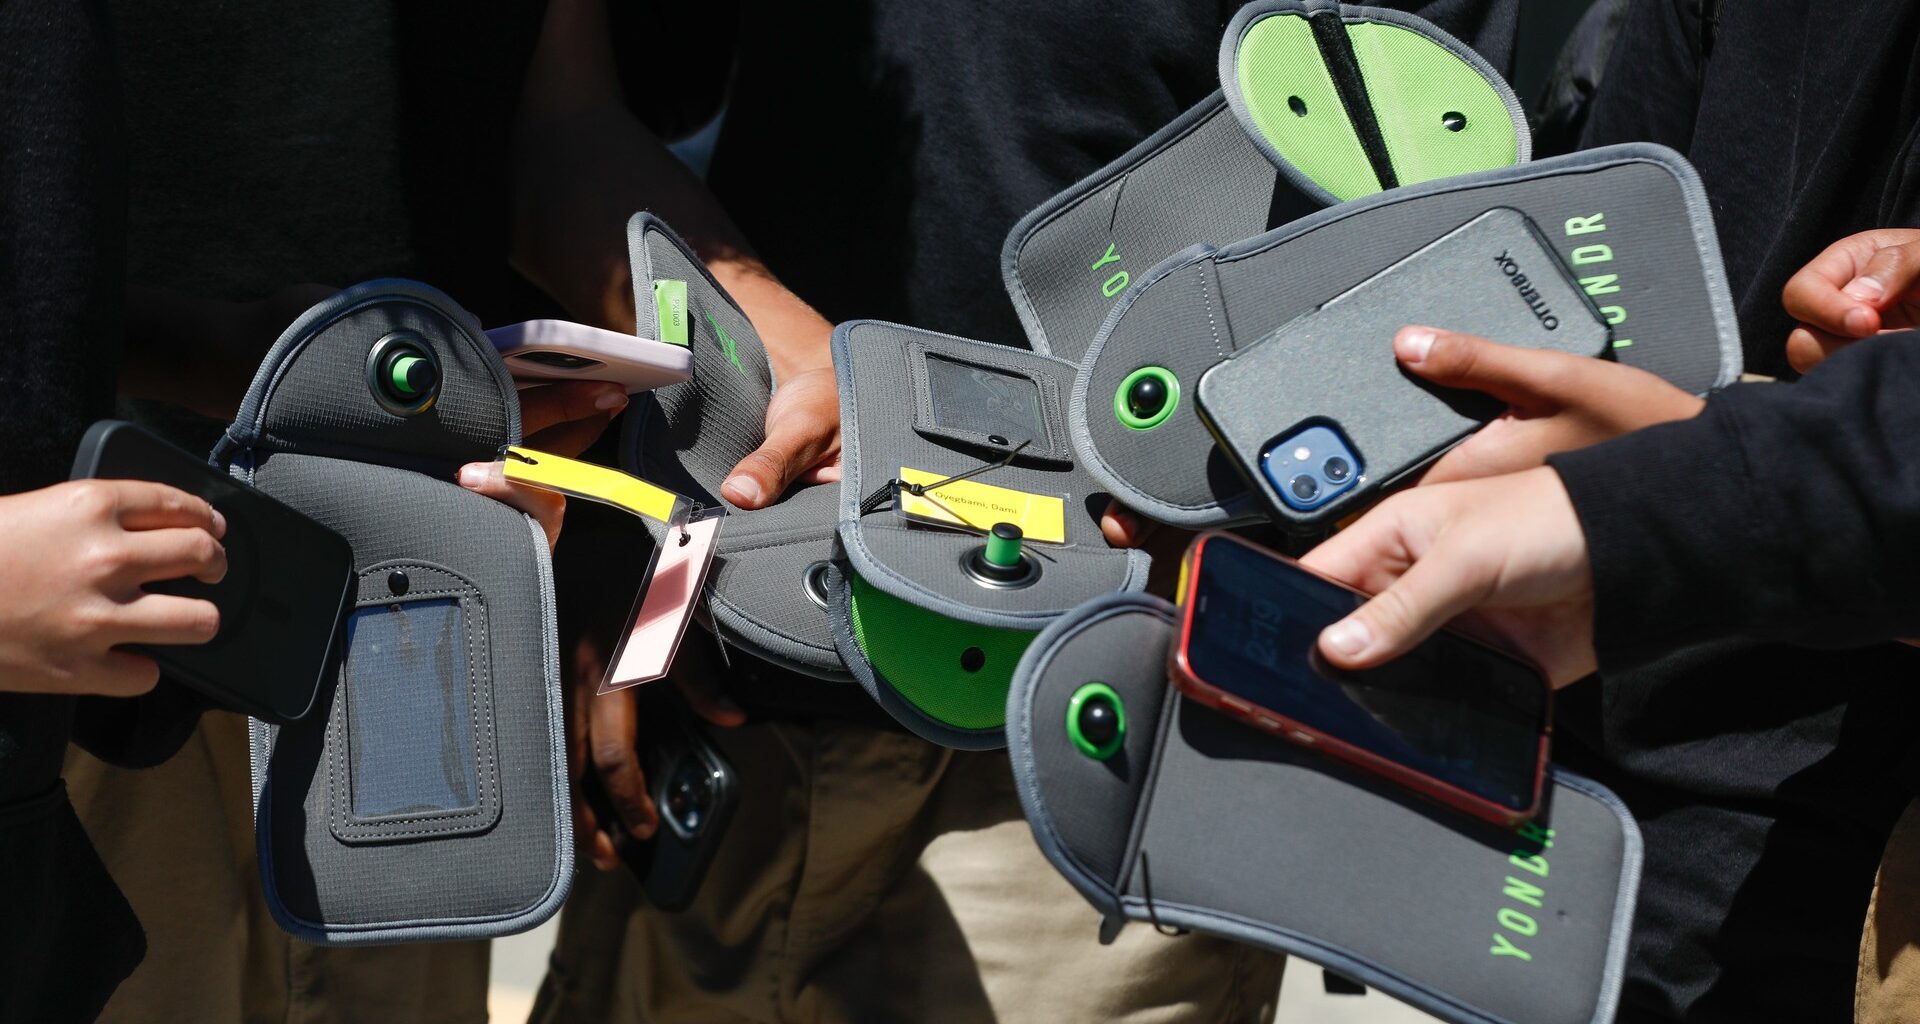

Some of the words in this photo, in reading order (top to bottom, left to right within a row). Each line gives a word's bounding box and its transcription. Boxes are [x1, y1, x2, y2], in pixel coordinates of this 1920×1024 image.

[1494, 249, 1559, 331] OTTERBOX
[934, 491, 989, 509] Oyegbami,
[991, 503, 1018, 515] Dami
[1489, 821, 1556, 962] YONDR
